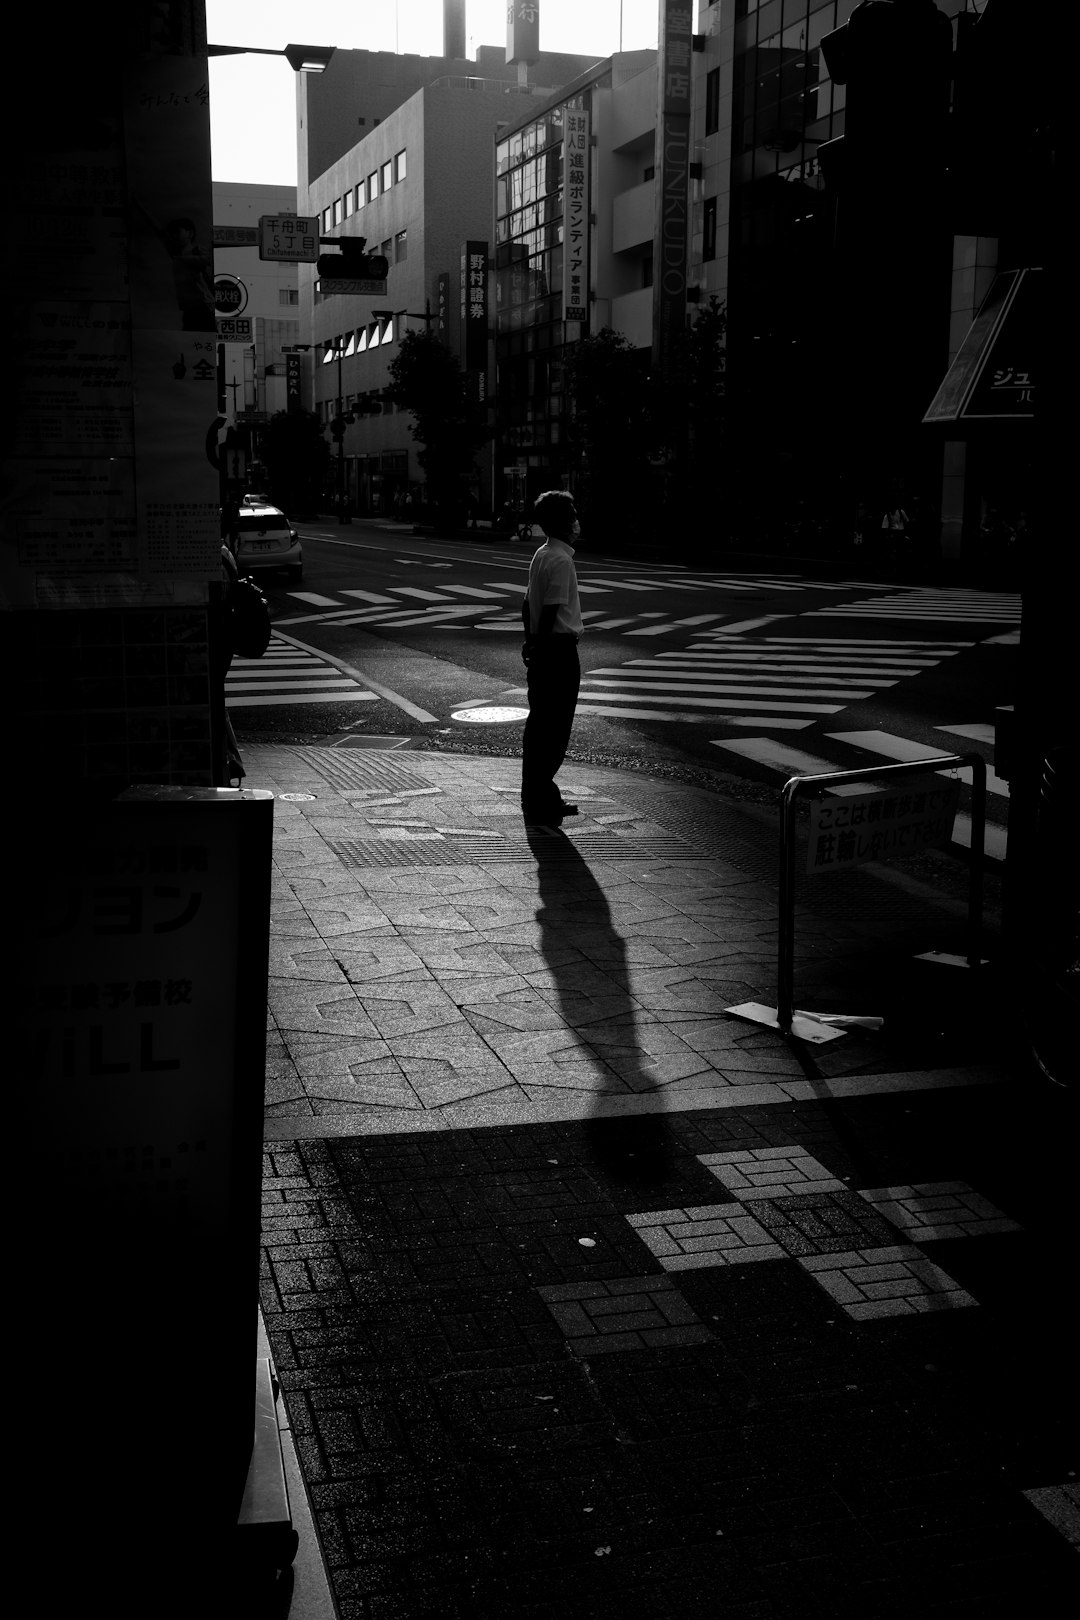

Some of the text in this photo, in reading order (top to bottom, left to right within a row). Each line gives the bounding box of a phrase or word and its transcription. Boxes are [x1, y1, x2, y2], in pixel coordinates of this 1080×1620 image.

[667, 7, 691, 99] 堂書店
[266, 219, 309, 234] 千舟町
[662, 121, 688, 296] JUNKUDO
[267, 247, 309, 257] Chifunemachi
[273, 234, 315, 249] 5丁目
[469, 254, 485, 319] 野村證券
[192, 358, 215, 381] 全
[818, 787, 955, 830] ここは横断歩道です
[814, 816, 949, 867] 駐輪しないで下さい
